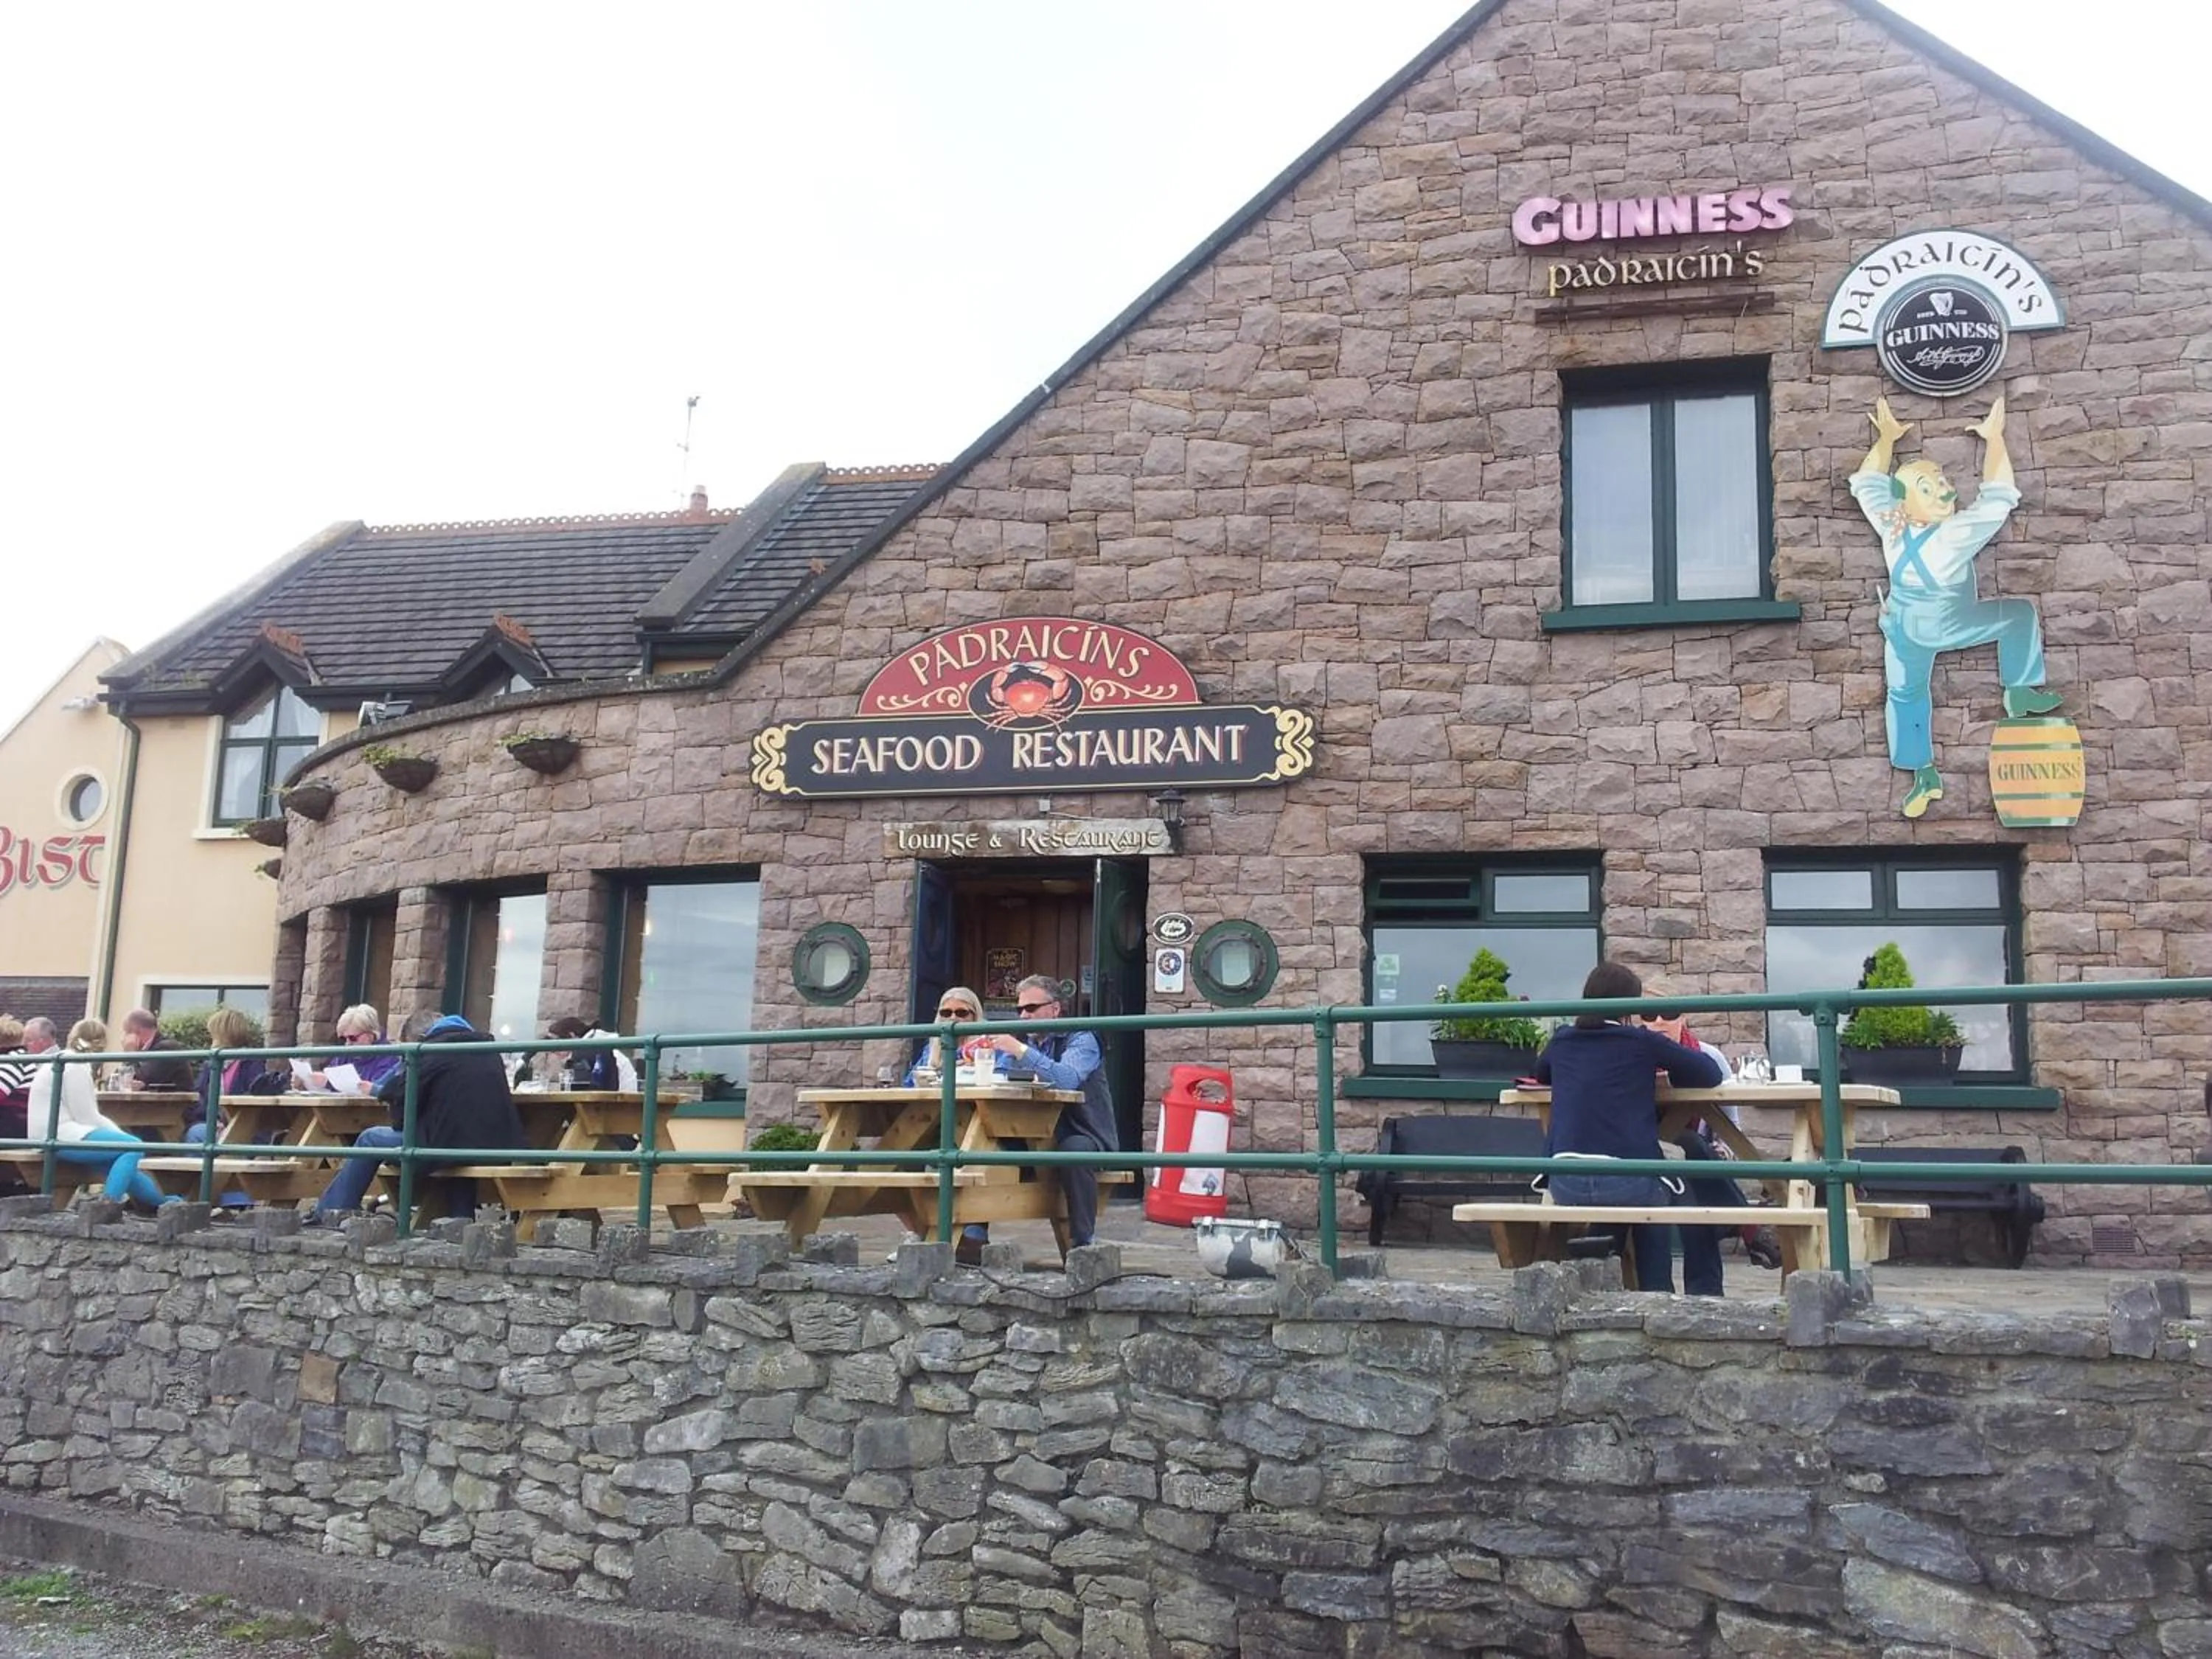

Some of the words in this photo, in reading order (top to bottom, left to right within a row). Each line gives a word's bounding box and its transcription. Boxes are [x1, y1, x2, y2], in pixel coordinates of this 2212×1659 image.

[1512, 187, 1793, 245] GUINNESS
[1886, 321, 2000, 347] GUINNESS
[811, 735, 982, 773] SEAFOOD
[1012, 726, 1248, 768] RESTAURANT
[1997, 762, 2080, 779] GUINNESS
[989, 834, 1002, 849] &
[1019, 827, 1163, 855] Restaurant
